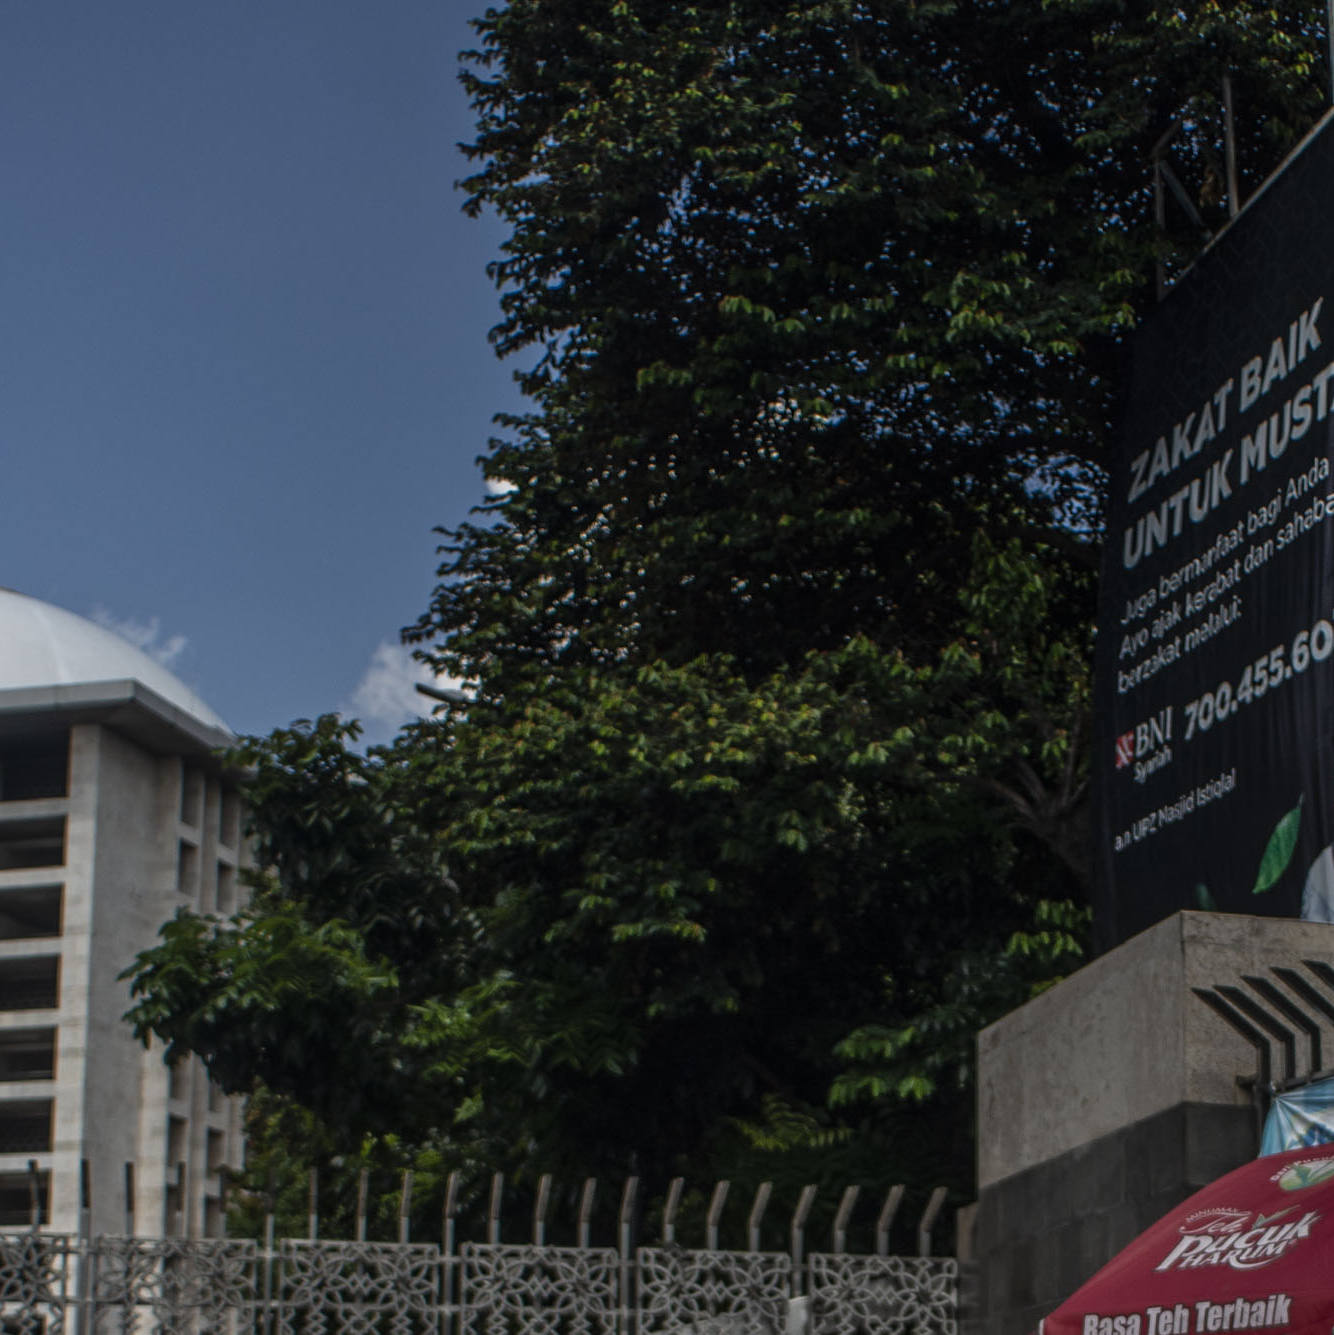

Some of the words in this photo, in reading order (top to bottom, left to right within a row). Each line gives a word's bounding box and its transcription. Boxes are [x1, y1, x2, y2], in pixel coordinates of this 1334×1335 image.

[1127, 377, 1234, 504] ZAKAT
[1238, 296, 1324, 415] BAIK
[1120, 588, 1158, 626] Juga
[1158, 519, 1244, 599] bermanfaat
[1246, 487, 1282, 536] bagi
[1284, 456, 1330, 507] Anda
[1122, 448, 1234, 570] UNTUK
[1118, 627, 1151, 661] Ayo
[1151, 600, 1183, 640] ajak
[1184, 558, 1242, 619] kerabat
[1243, 537, 1275, 575] dan
[1118, 635, 1182, 695] berzakat
[1135, 705, 1174, 760] BNI
[1158, 789, 1196, 828] Masjid
[1196, 766, 1237, 808] Istiqlal
[1195, 1293, 1292, 1334] Terbaik
